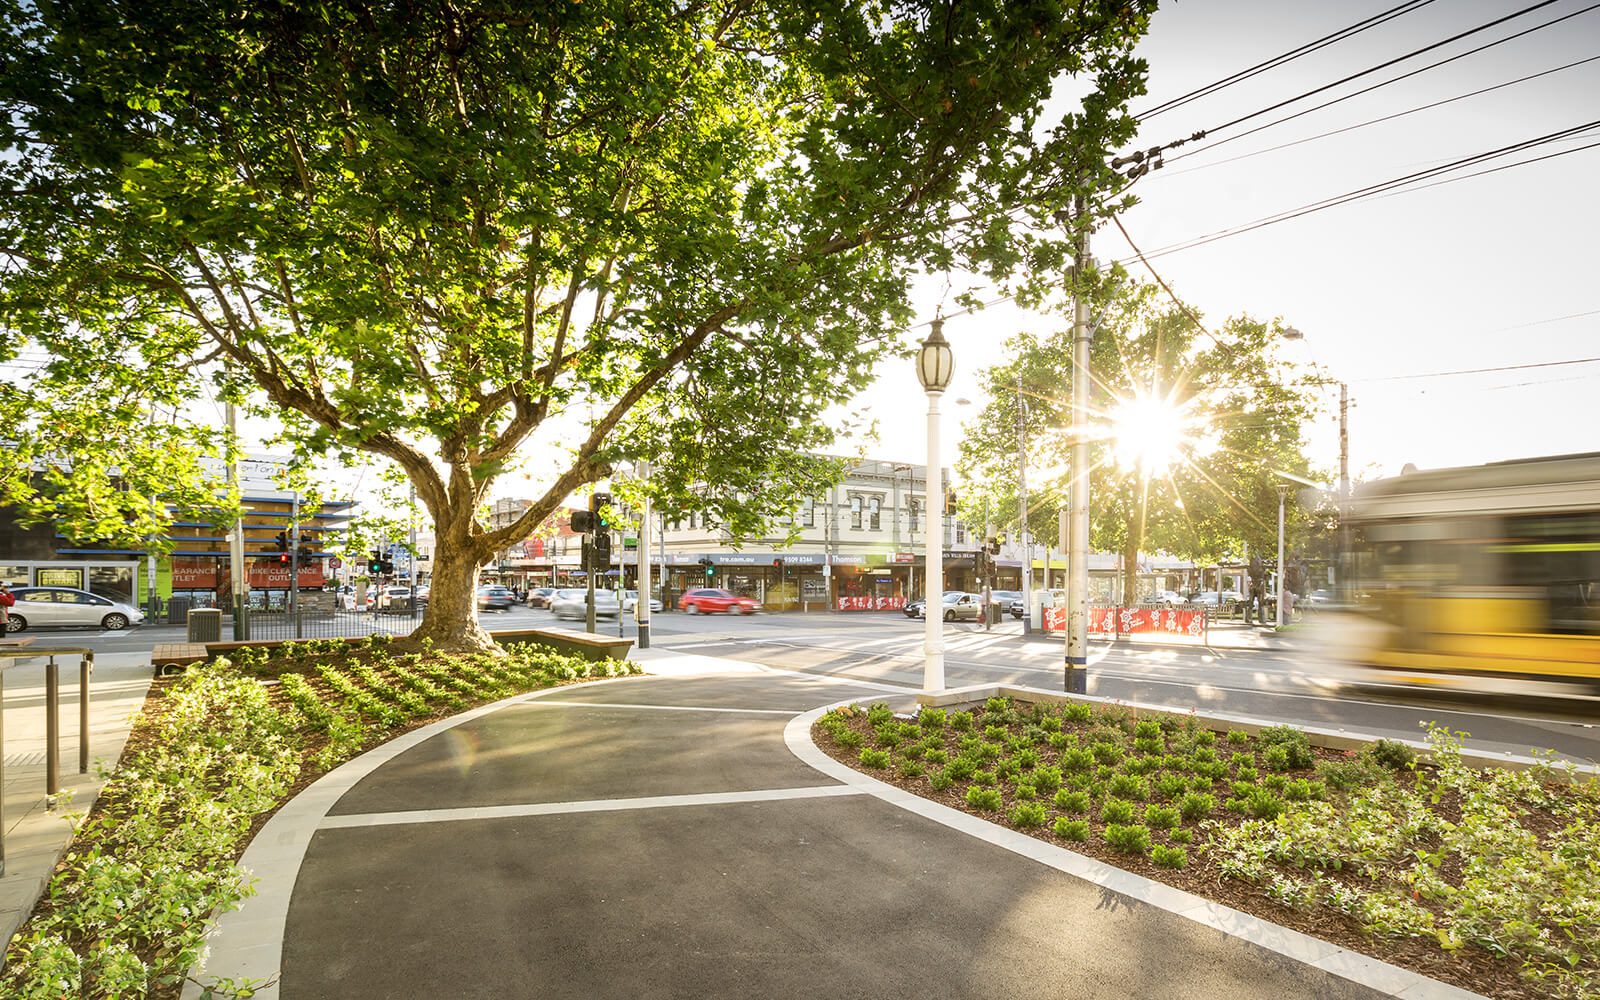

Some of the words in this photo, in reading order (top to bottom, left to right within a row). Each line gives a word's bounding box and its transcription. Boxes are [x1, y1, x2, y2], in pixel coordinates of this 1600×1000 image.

[831, 554, 862, 563] Thomson
[173, 567, 216, 575] EARANCE
[249, 567, 269, 575] BIKE
[270, 567, 317, 575] CLEAANCE
